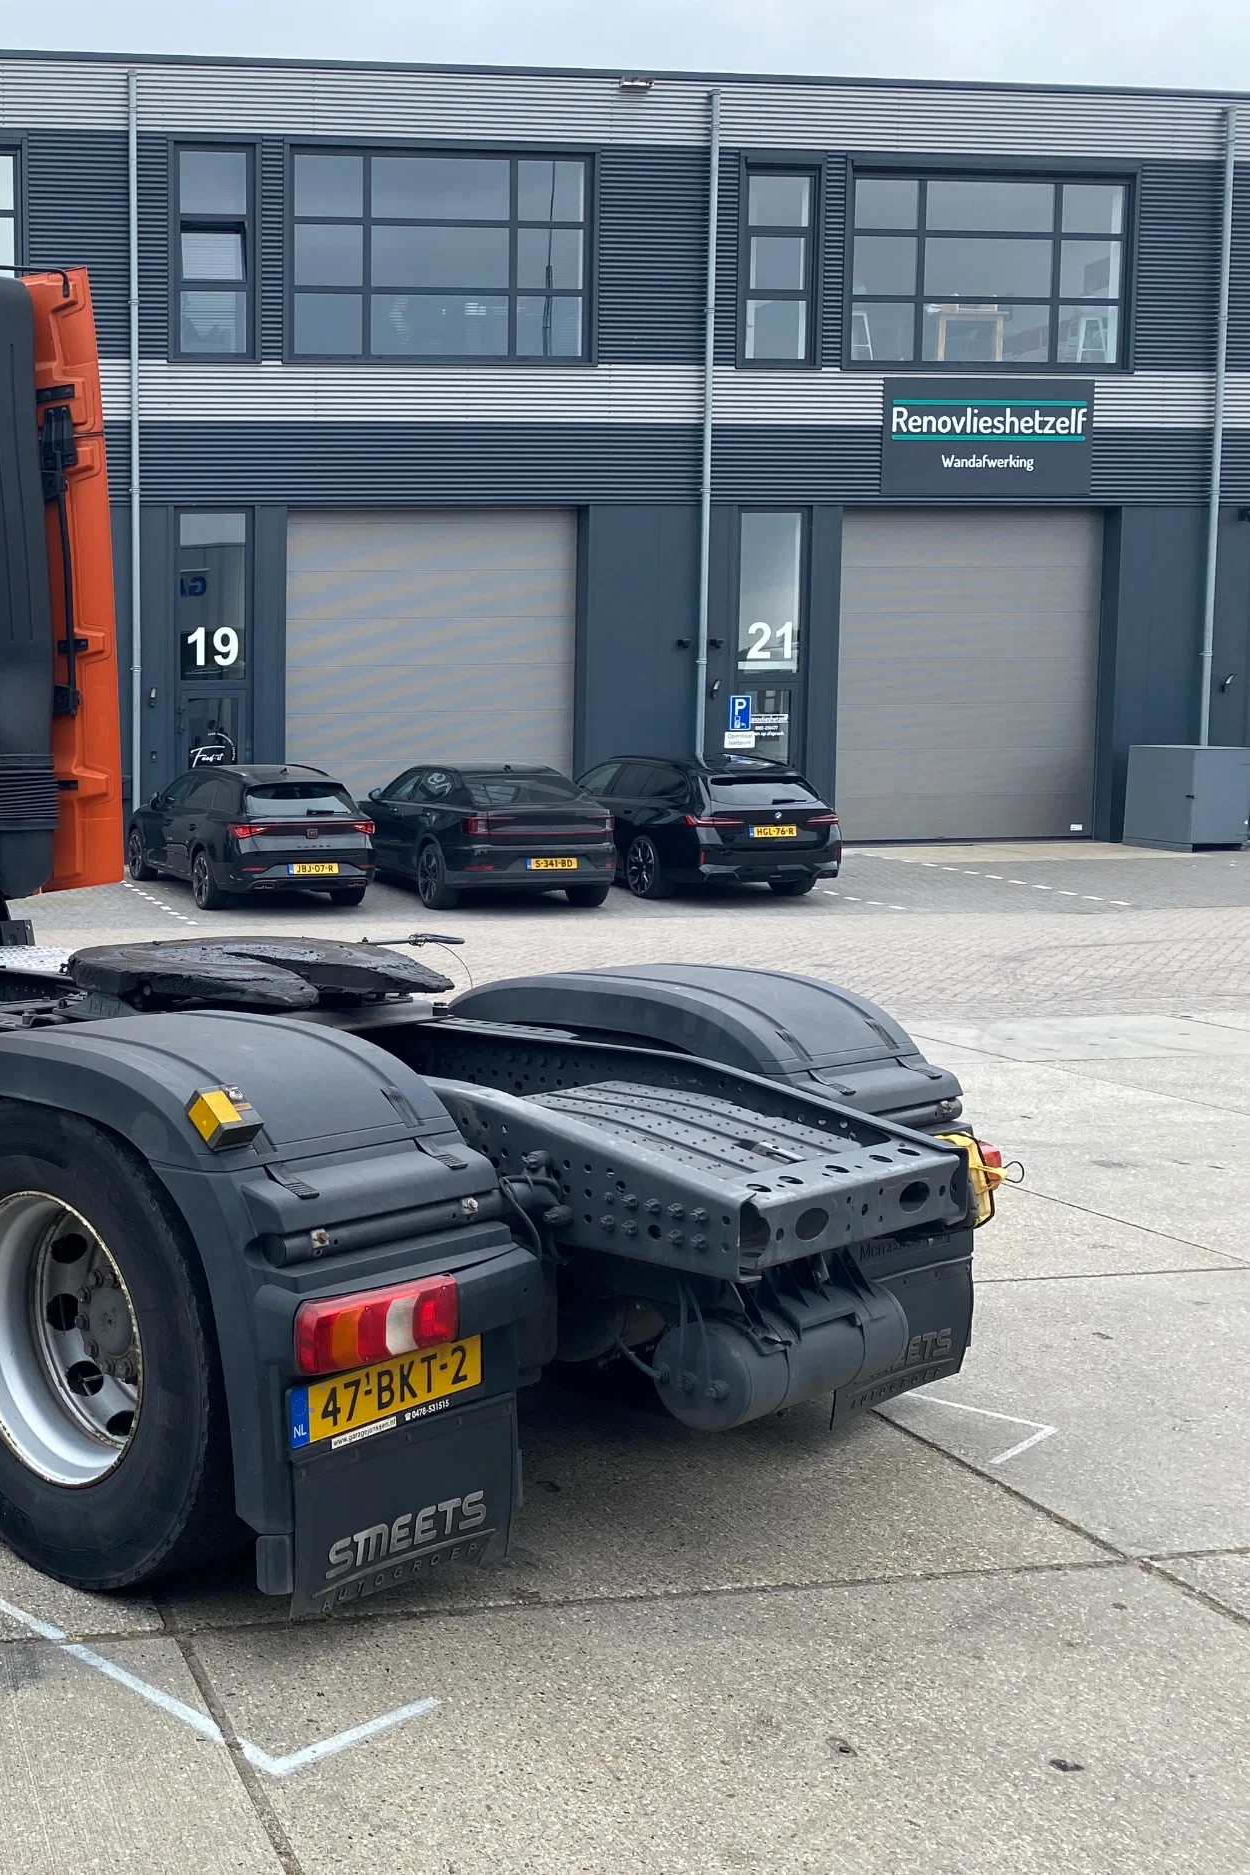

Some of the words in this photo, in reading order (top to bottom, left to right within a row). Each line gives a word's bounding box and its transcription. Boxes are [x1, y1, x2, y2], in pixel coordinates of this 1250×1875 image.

[891, 406, 1088, 435] Renovlieshetzelf
[941, 454, 1035, 472] Wandafwerking
[187, 626, 239, 666] 19
[746, 621, 793, 659] 21
[735, 698, 747, 716] P
[756, 827, 795, 836] HGL-76-R
[296, 864, 334, 873] JBJ-07-R
[534, 859, 573, 868] S-341-BD
[900, 1328, 952, 1366] ETS
[293, 1421, 308, 1438] NL
[320, 1344, 468, 1428] 47-BKT-2
[333, 1418, 397, 1447] www.garagejanssen.nl
[324, 1490, 488, 1580] SMEETS
[321, 1542, 478, 1613] AUTOGROEP
